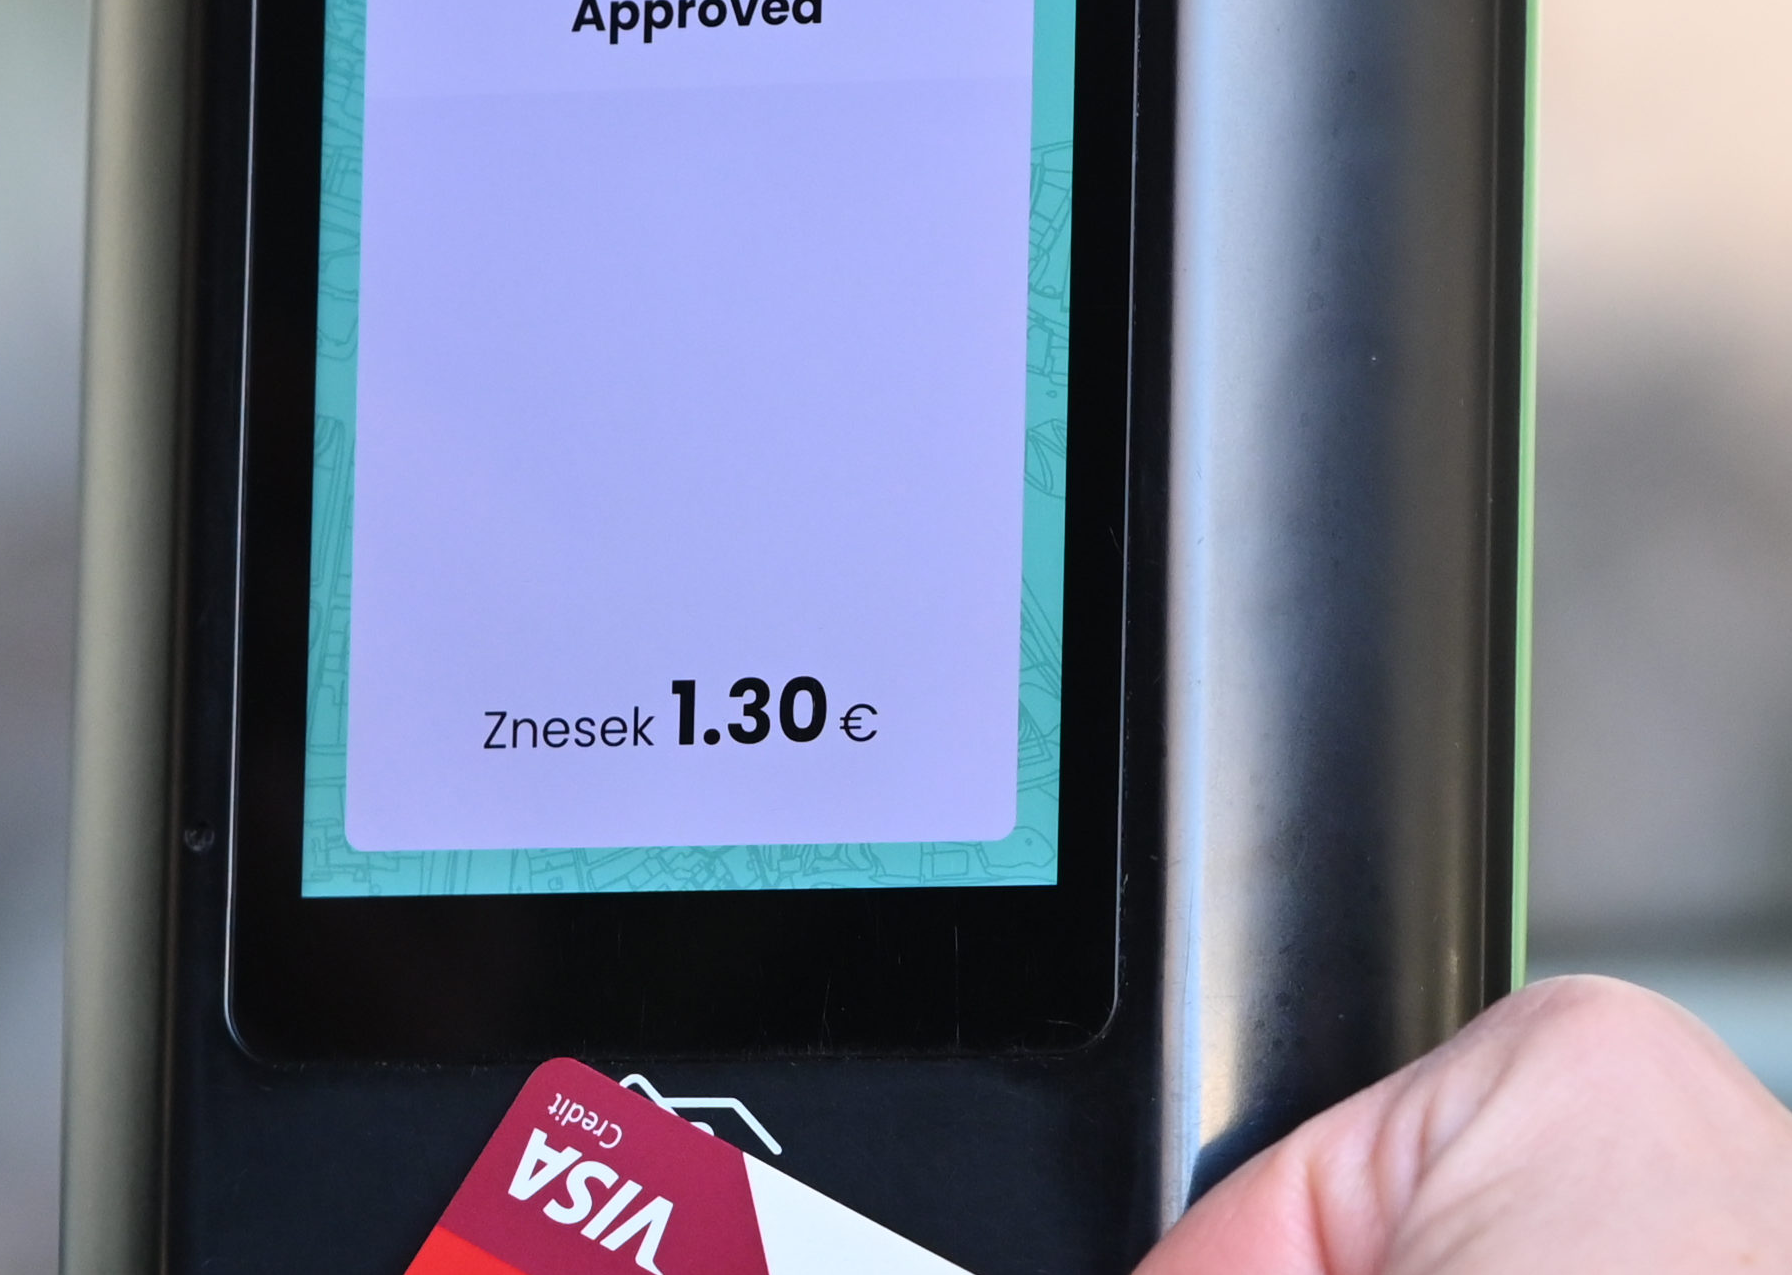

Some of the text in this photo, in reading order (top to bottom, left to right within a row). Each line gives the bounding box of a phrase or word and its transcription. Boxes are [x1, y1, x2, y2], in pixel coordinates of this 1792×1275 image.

[483, 675, 879, 750] Znesek 1.30 €
[547, 1092, 624, 1150] Credit
